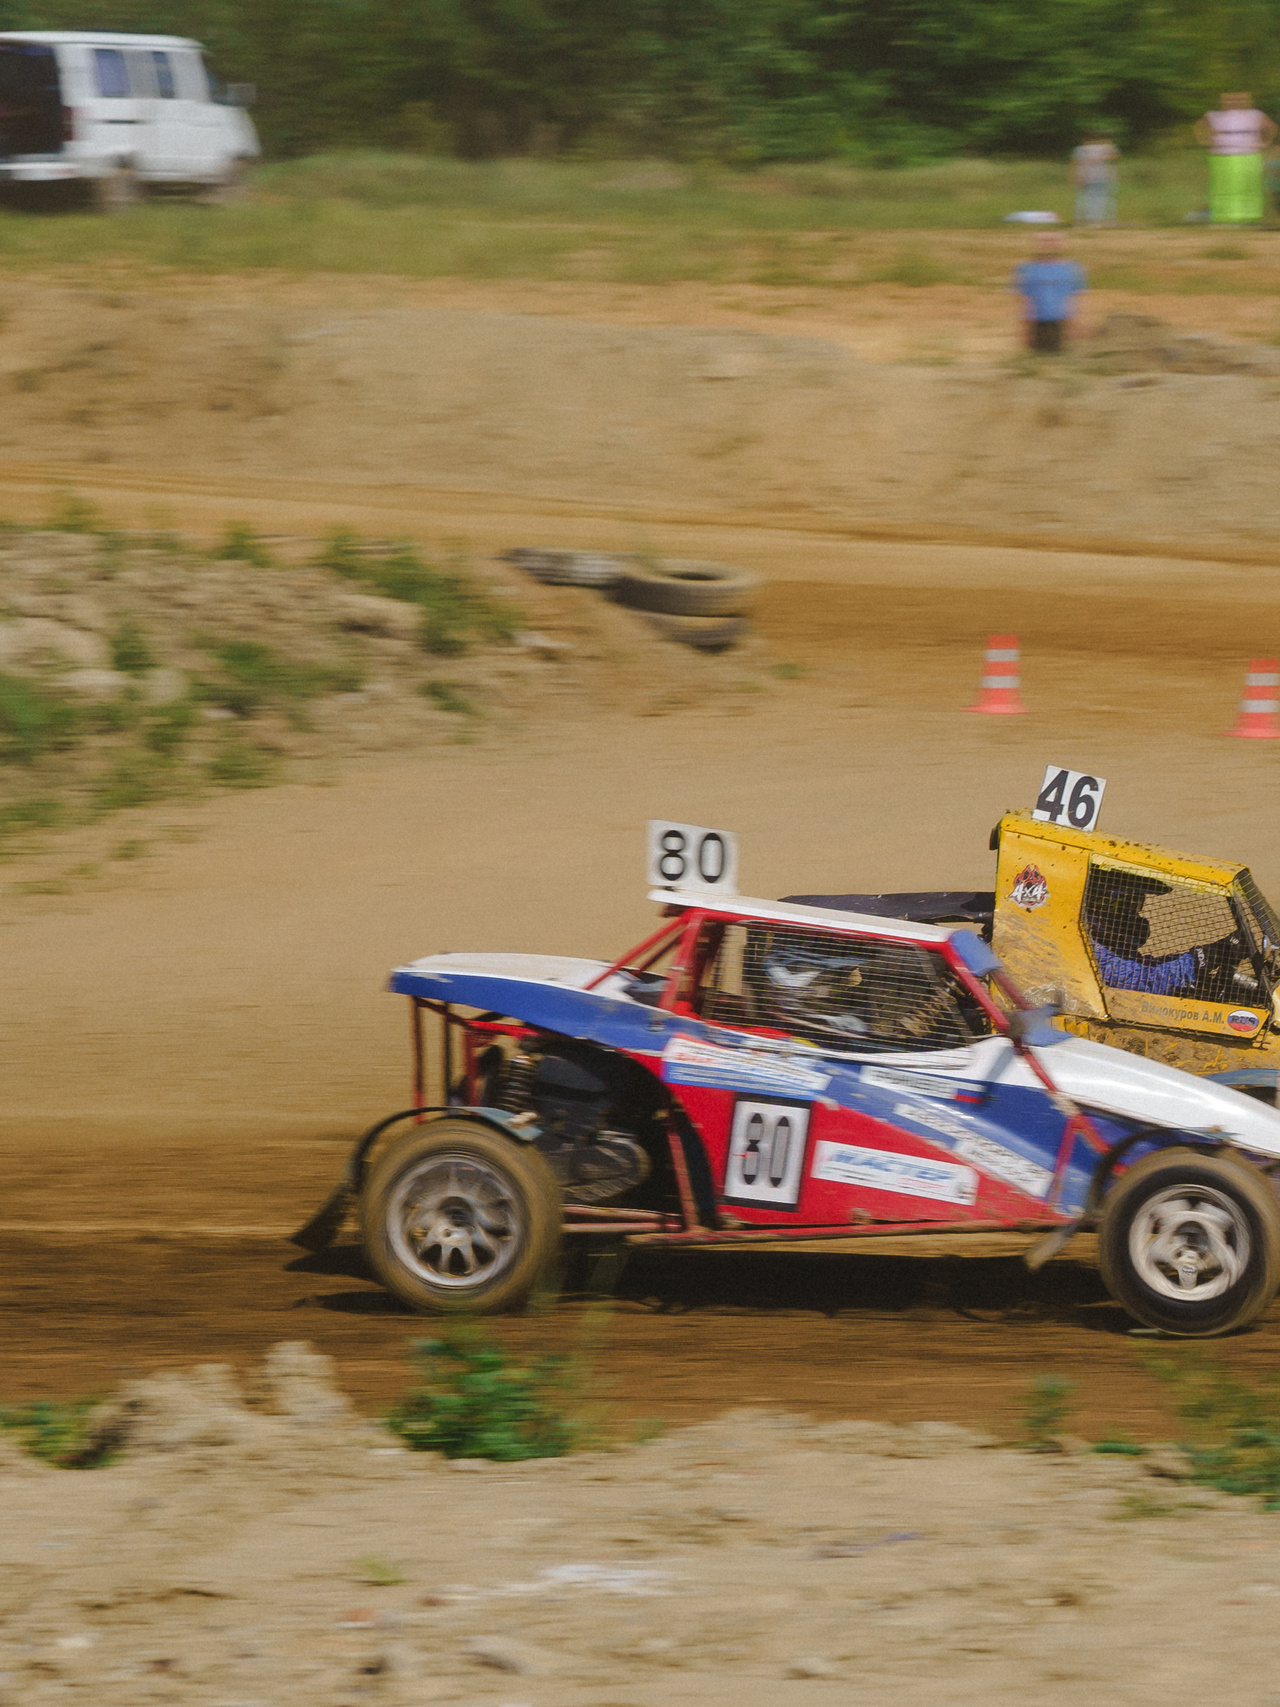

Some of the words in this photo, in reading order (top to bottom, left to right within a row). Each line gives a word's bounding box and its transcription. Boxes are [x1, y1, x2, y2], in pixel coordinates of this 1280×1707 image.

[1036, 769, 1099, 828] 46
[660, 830, 725, 884] 80
[1141, 1001, 1199, 1021] Винокуров
[742, 1112, 791, 1188] 80
